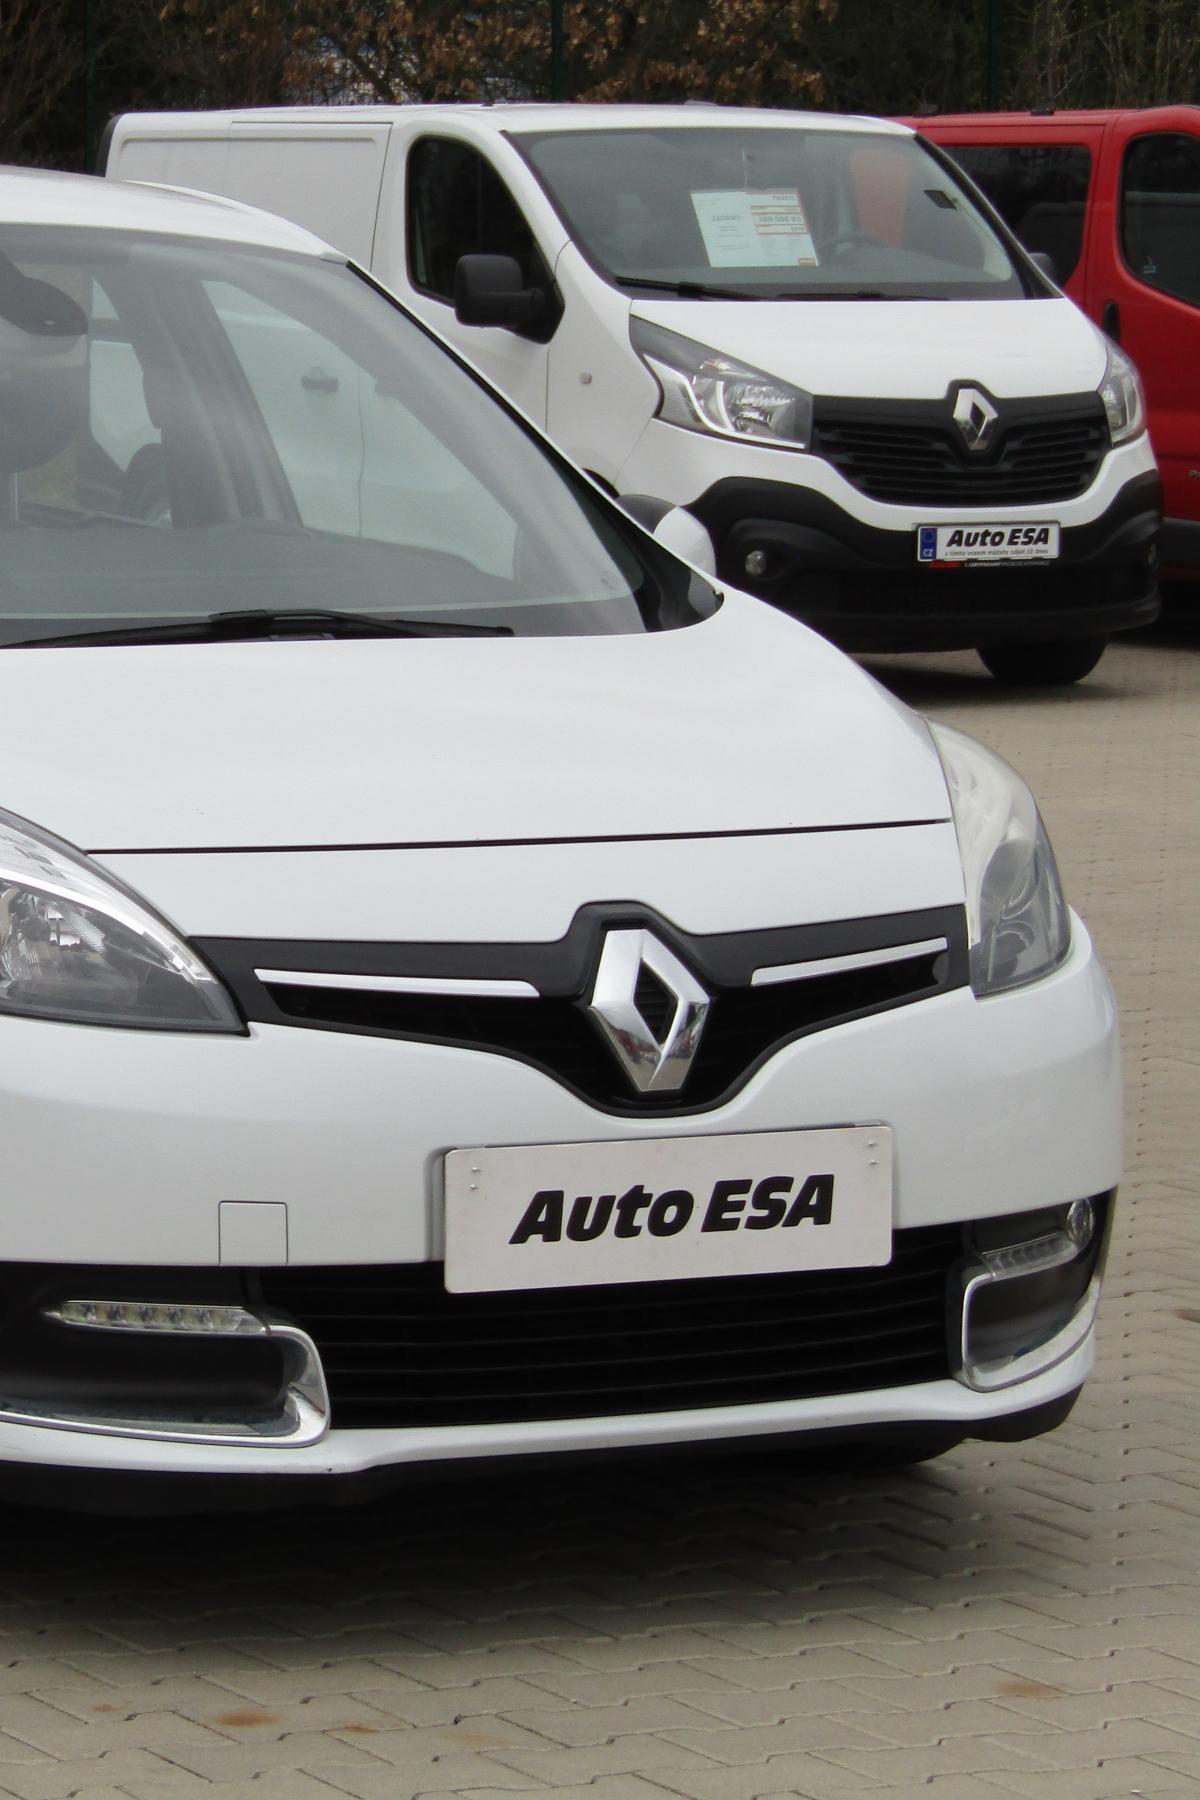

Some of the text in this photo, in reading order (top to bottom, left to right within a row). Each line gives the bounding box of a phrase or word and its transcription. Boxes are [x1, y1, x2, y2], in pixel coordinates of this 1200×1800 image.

[946, 527, 1050, 548] Auto ESA
[922, 548, 933, 557] CZ
[508, 1173, 835, 1244] Auto ESA
